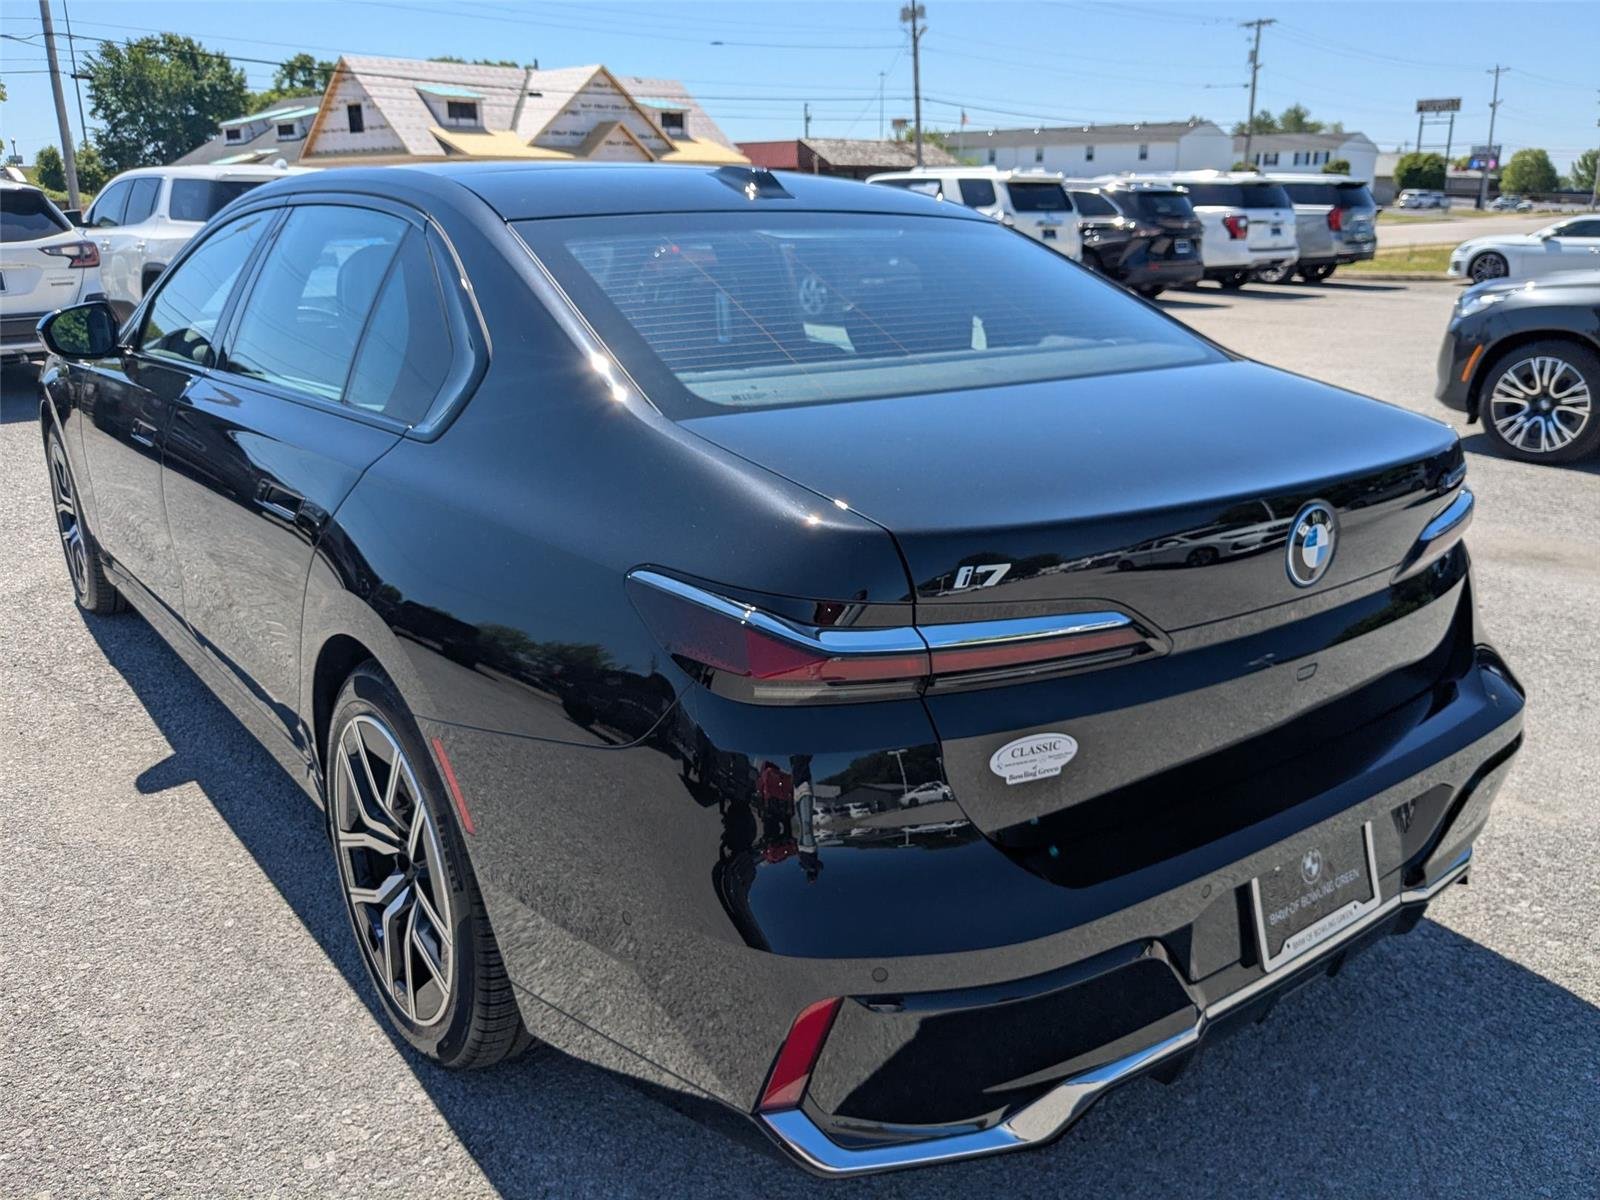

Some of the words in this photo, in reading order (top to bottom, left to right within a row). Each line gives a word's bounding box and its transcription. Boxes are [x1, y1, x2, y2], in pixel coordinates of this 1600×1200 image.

[1297, 510, 1332, 537] BMW
[953, 563, 1011, 588] i7
[1011, 740, 1062, 759] CLASSIC
[1038, 766, 1059, 775] Green
[1289, 899, 1299, 914] OF
[1300, 881, 1335, 908] BOWLING
[1335, 868, 1359, 888] GREEN
